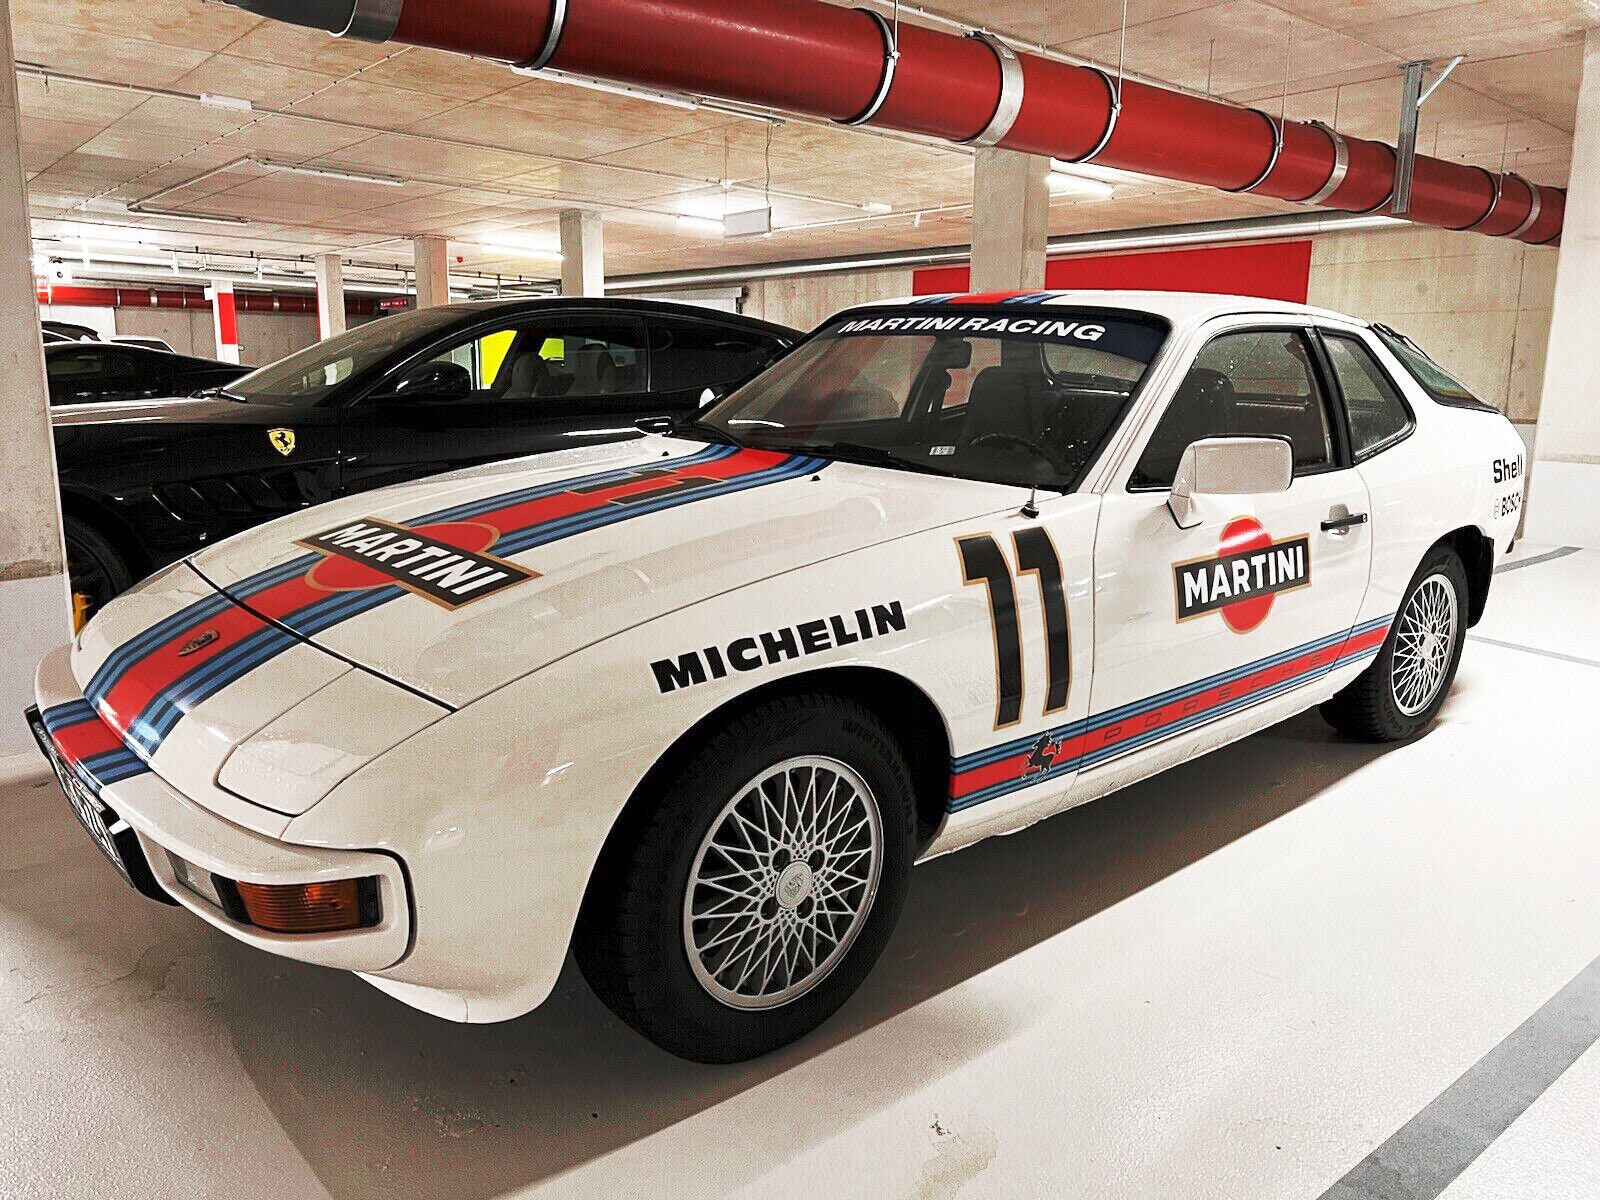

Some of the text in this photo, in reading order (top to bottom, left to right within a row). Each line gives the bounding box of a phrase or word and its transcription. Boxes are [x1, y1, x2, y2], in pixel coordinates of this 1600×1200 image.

[838, 317, 1106, 342] MARTINI RACING
[1493, 454, 1523, 484] Shell
[318, 523, 509, 596] MARTINI
[1183, 545, 1304, 608] MARTINI
[650, 600, 907, 694] MICHELIN
[953, 525, 1073, 731] 11
[1104, 655, 1321, 742] PORSCHE
